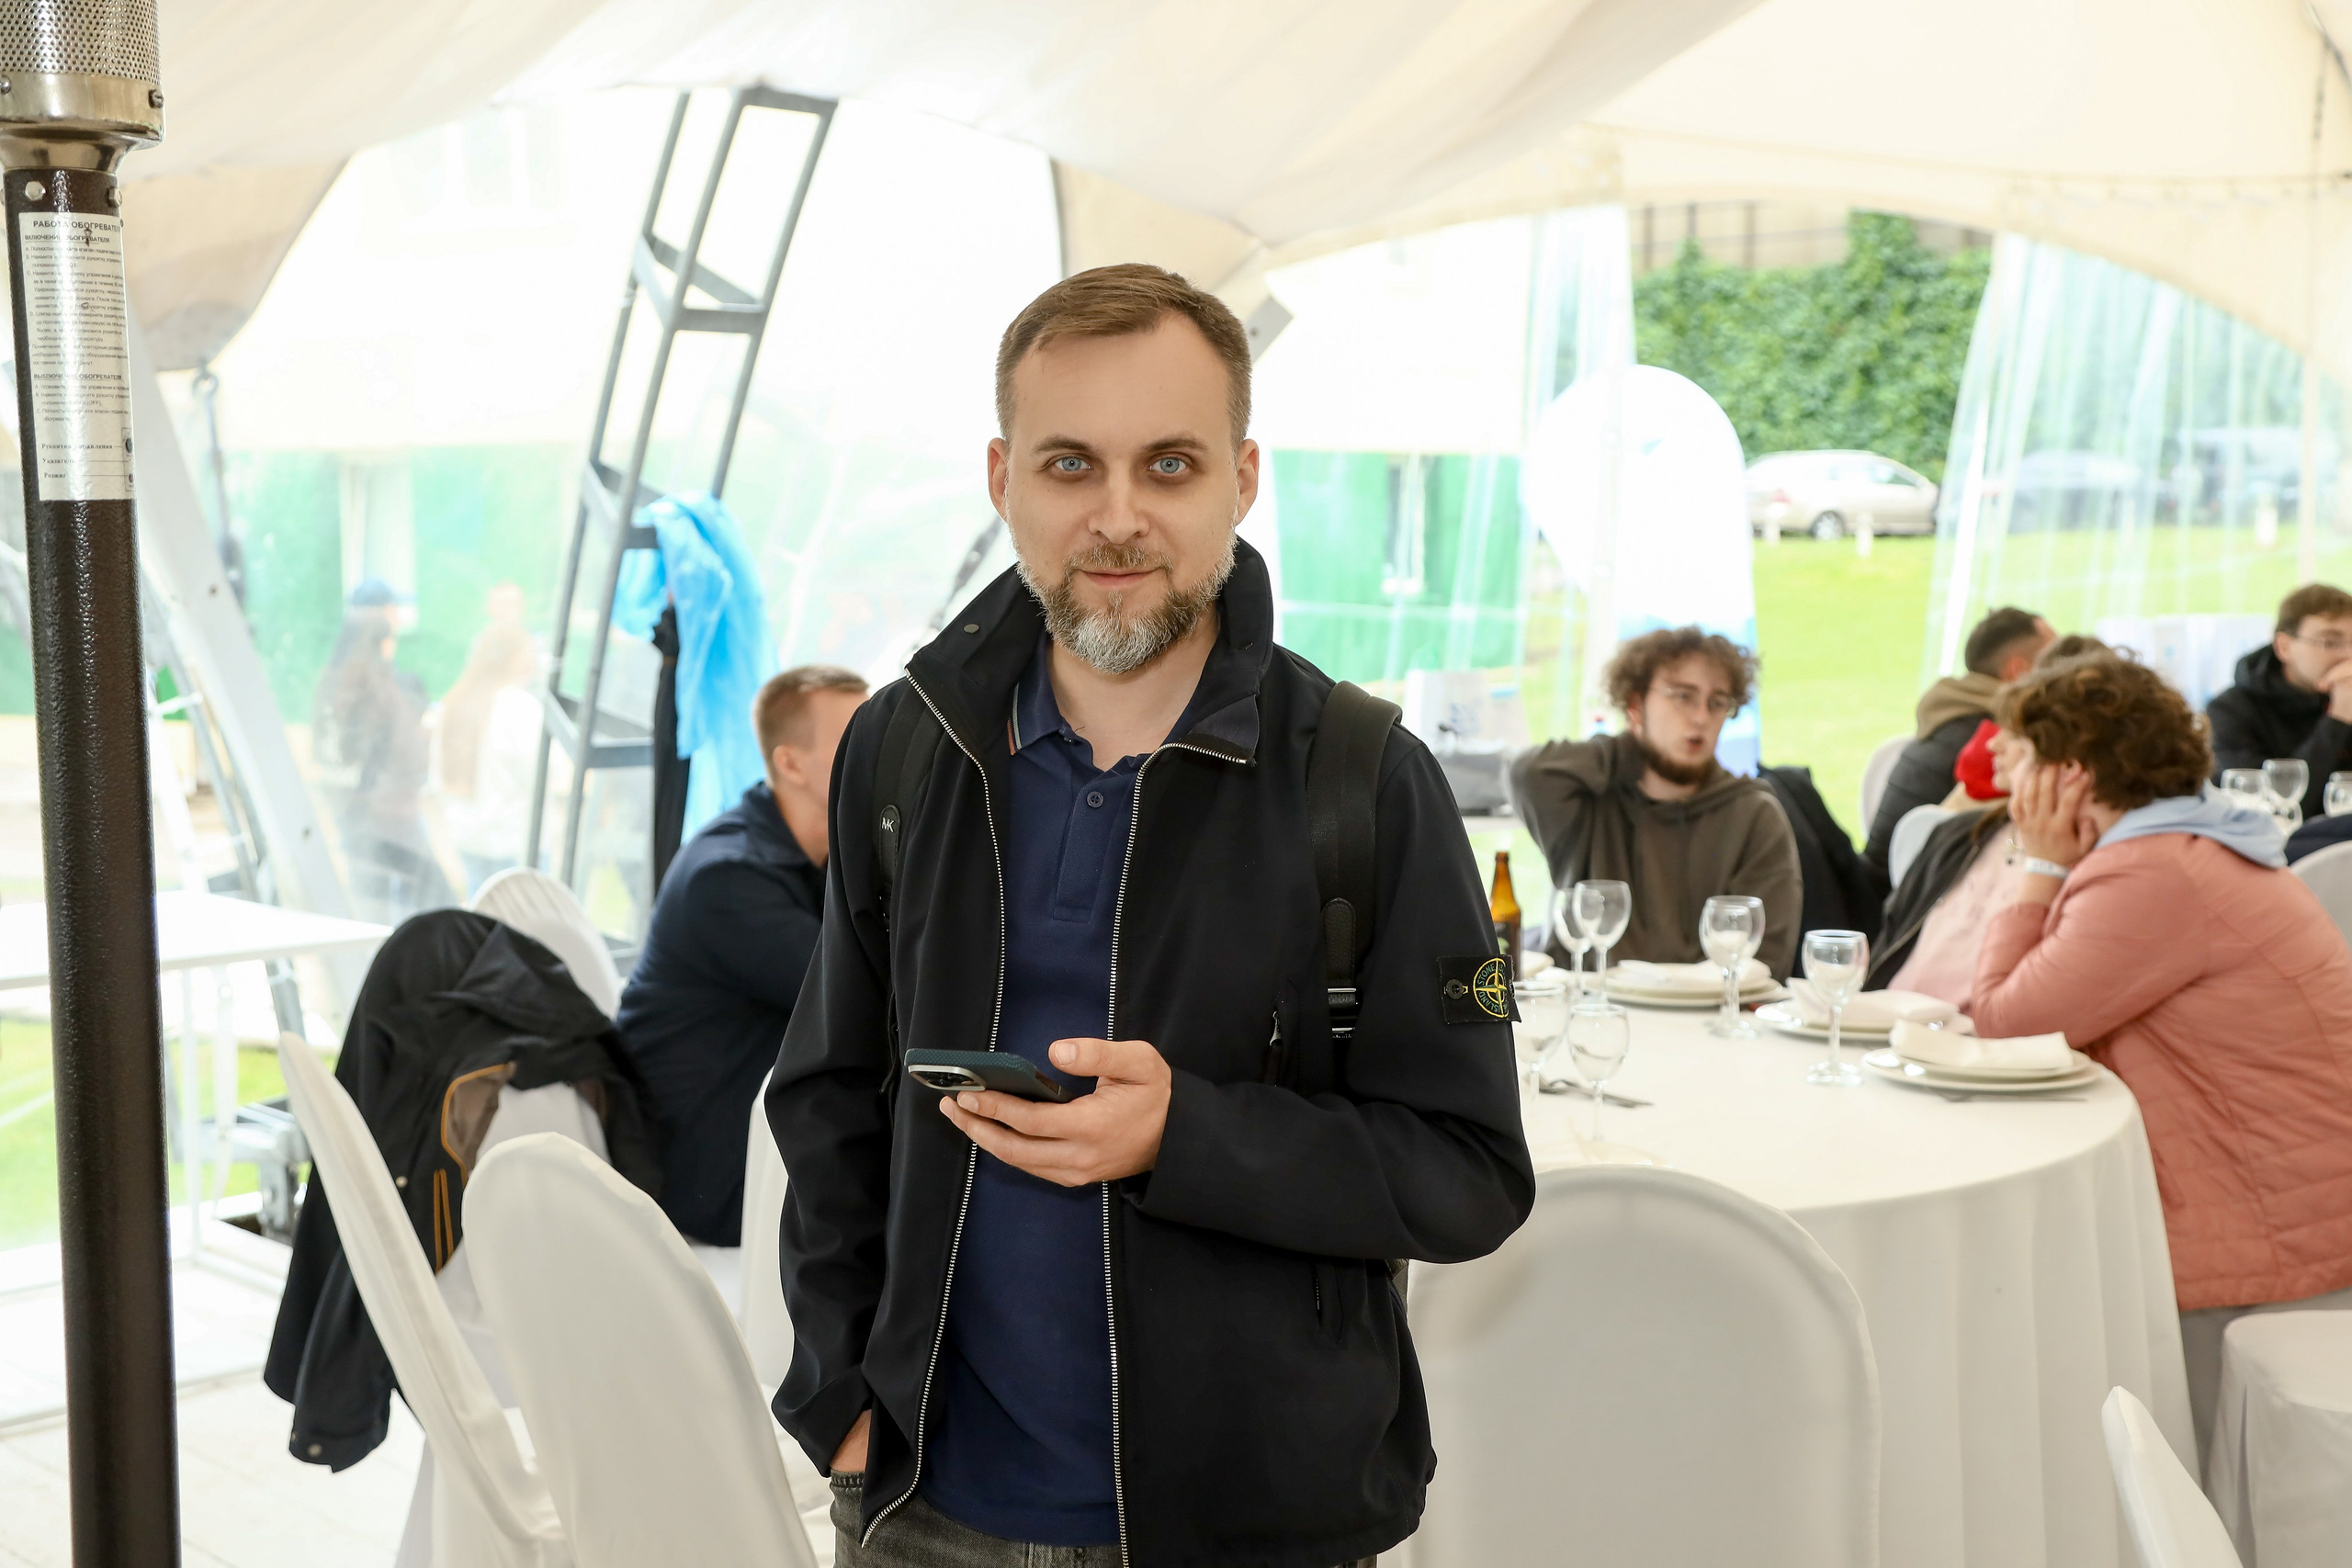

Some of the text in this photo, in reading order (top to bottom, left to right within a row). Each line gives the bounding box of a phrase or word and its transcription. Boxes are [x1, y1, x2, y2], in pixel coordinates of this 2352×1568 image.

[72, 221, 121, 232] ОБОГРЕВАТЕЛ
[66, 235, 110, 243] БОГРВАТЕЛЯ
[881, 817, 895, 833] MK
[1477, 964, 1496, 986] STONE
[1479, 991, 1500, 1013] ISLAND
